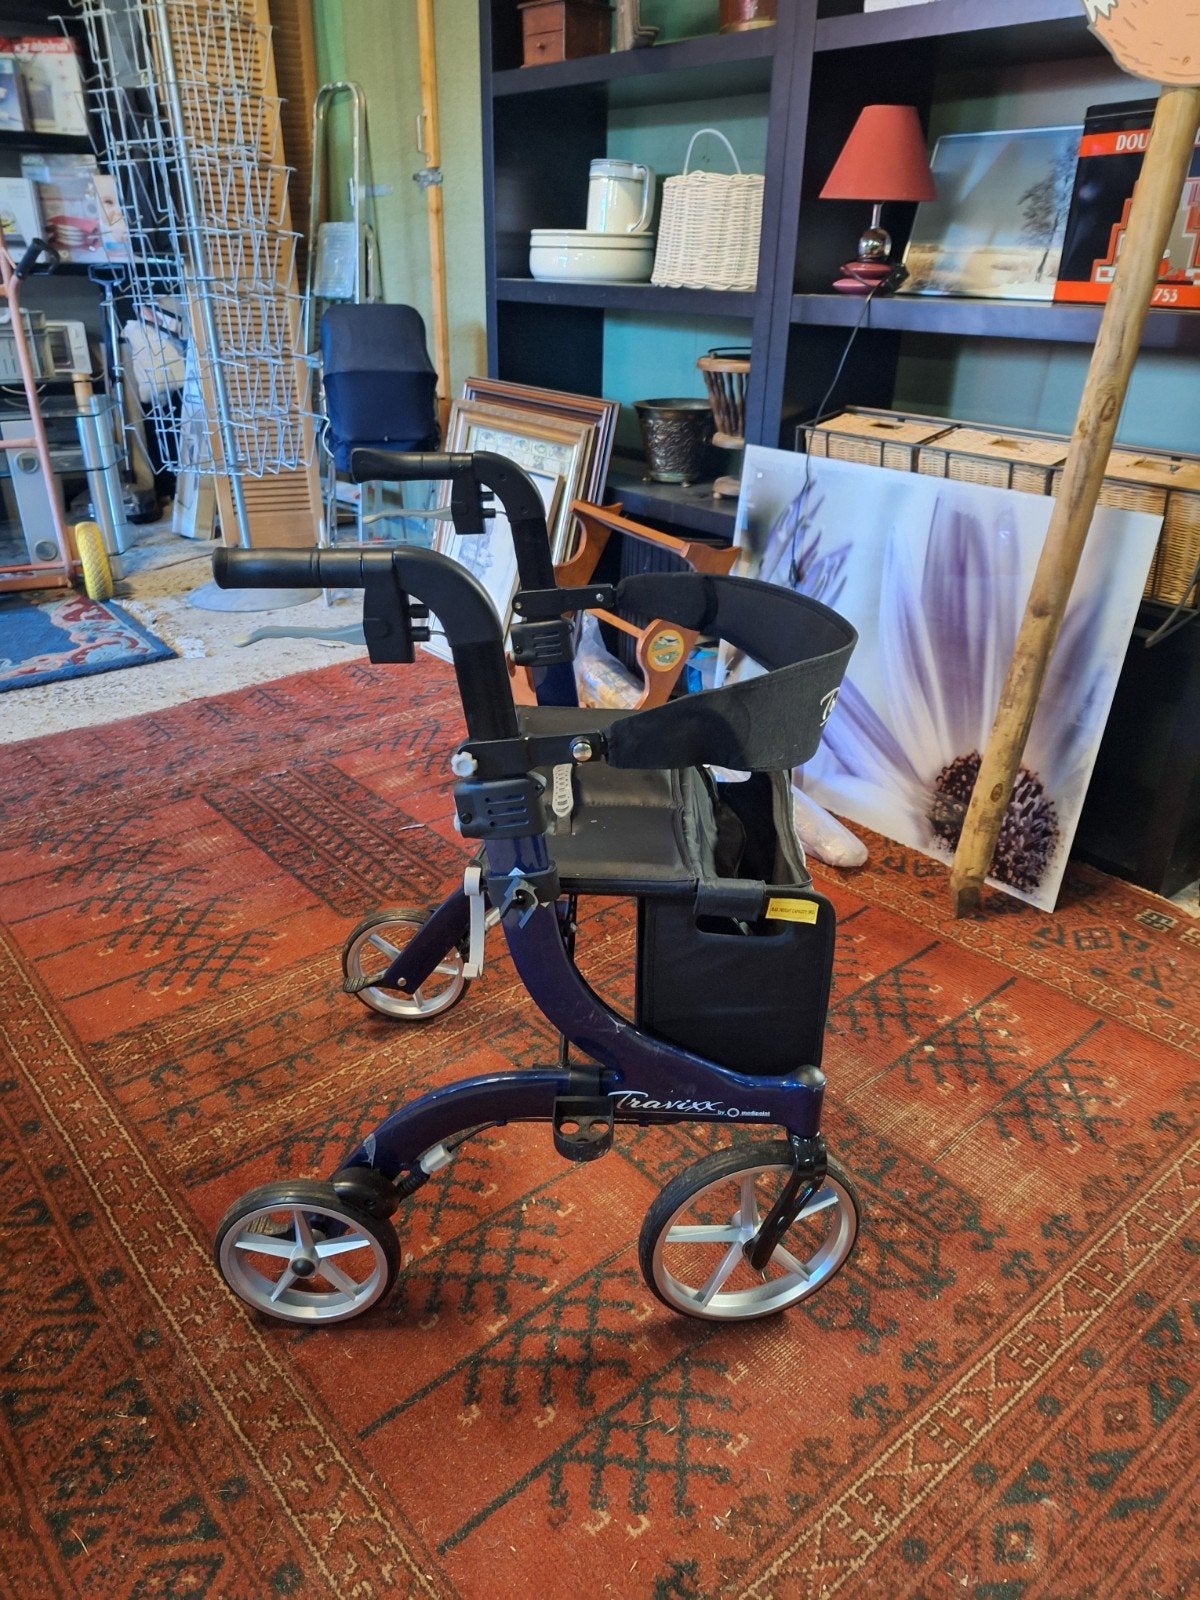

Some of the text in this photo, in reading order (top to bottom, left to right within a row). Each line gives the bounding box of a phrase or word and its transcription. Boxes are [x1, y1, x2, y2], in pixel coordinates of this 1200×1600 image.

[1115, 133, 1149, 151] DOU
[1152, 287, 1178, 303] 753
[607, 1090, 723, 1112] Travixx
